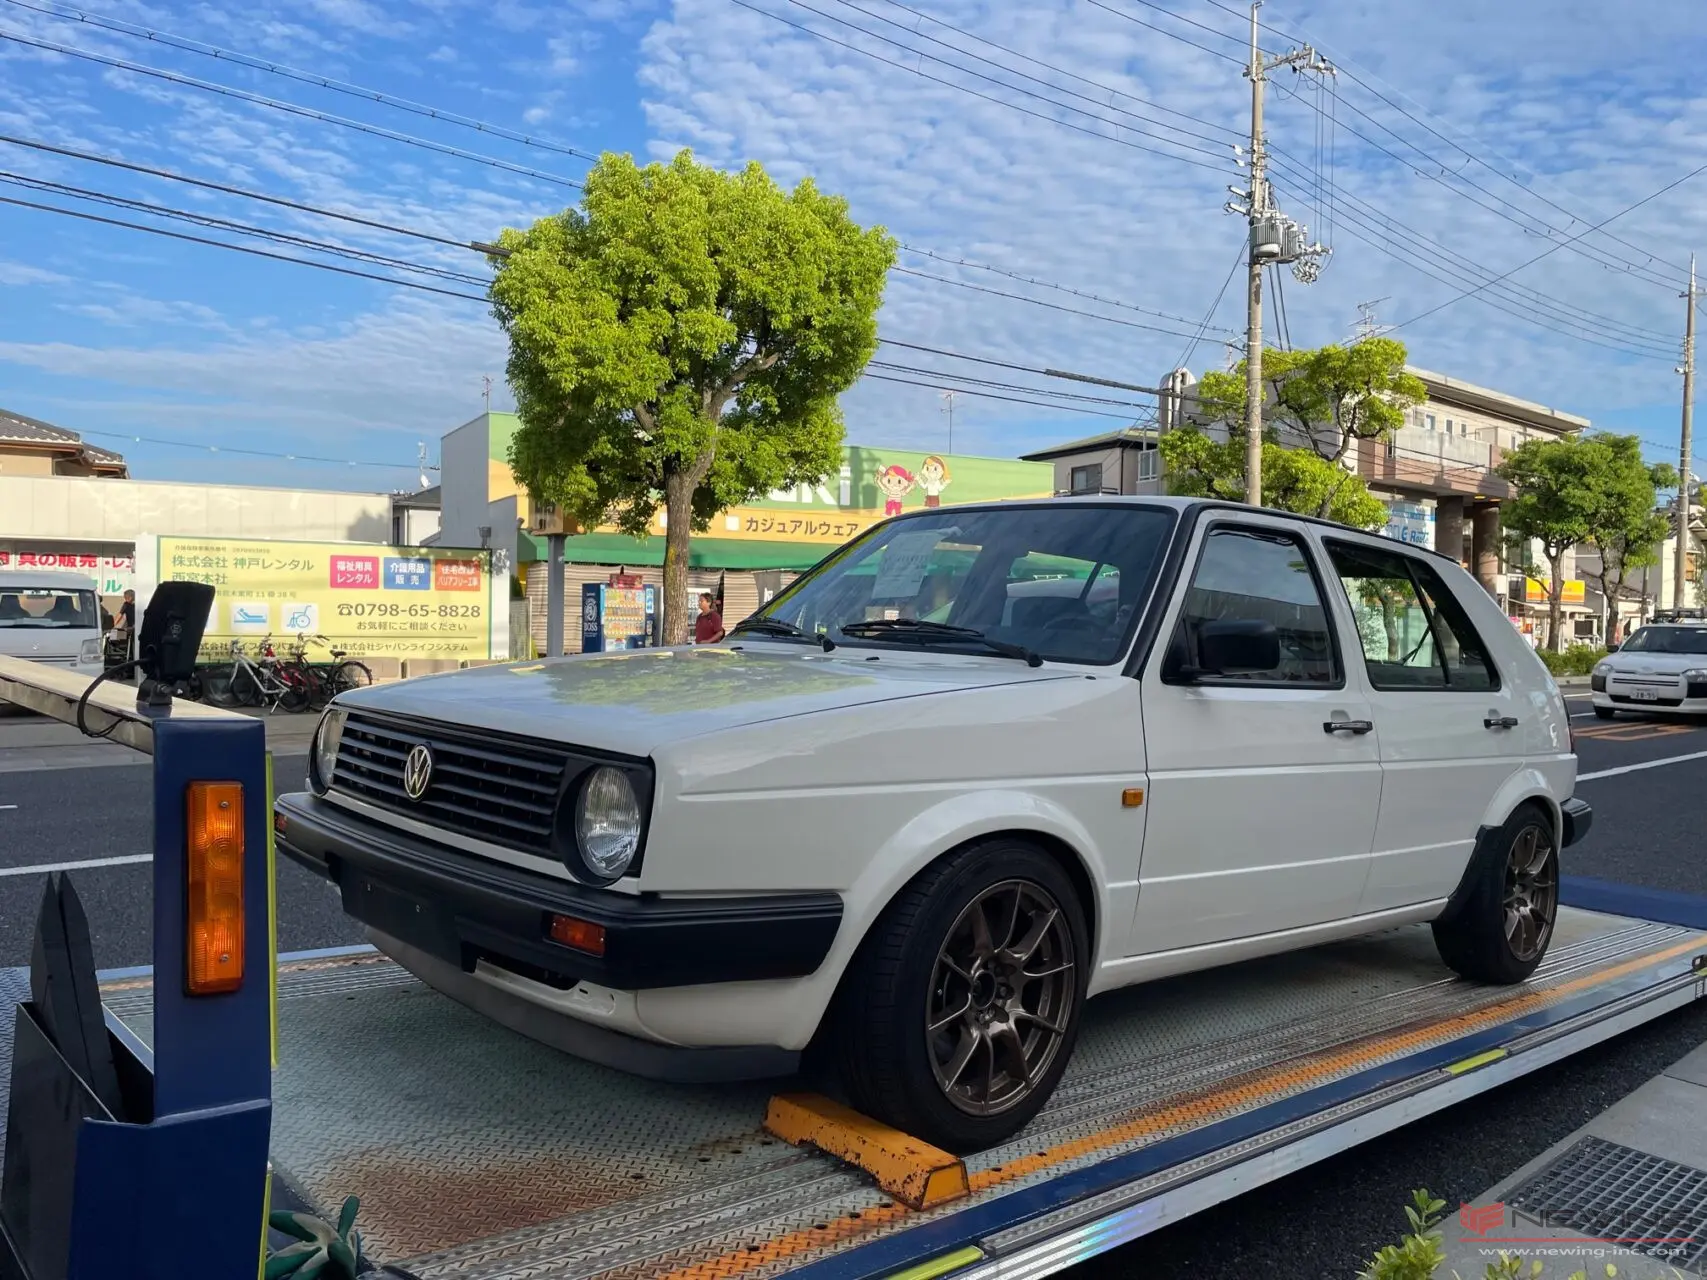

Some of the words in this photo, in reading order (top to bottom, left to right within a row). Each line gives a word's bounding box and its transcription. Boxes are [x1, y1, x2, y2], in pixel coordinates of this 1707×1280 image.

[746, 517, 859, 537] カジュアルウェア
[172, 555, 228, 569] 株式会社
[233, 557, 315, 571] 神戸レンタル
[336, 560, 373, 572] 福祉用具
[389, 562, 425, 574] 介護用品
[336, 574, 373, 584] レンタル
[354, 603, 481, 618] 0798-65-8828
[356, 621, 468, 631] お気軽にご相談ください
